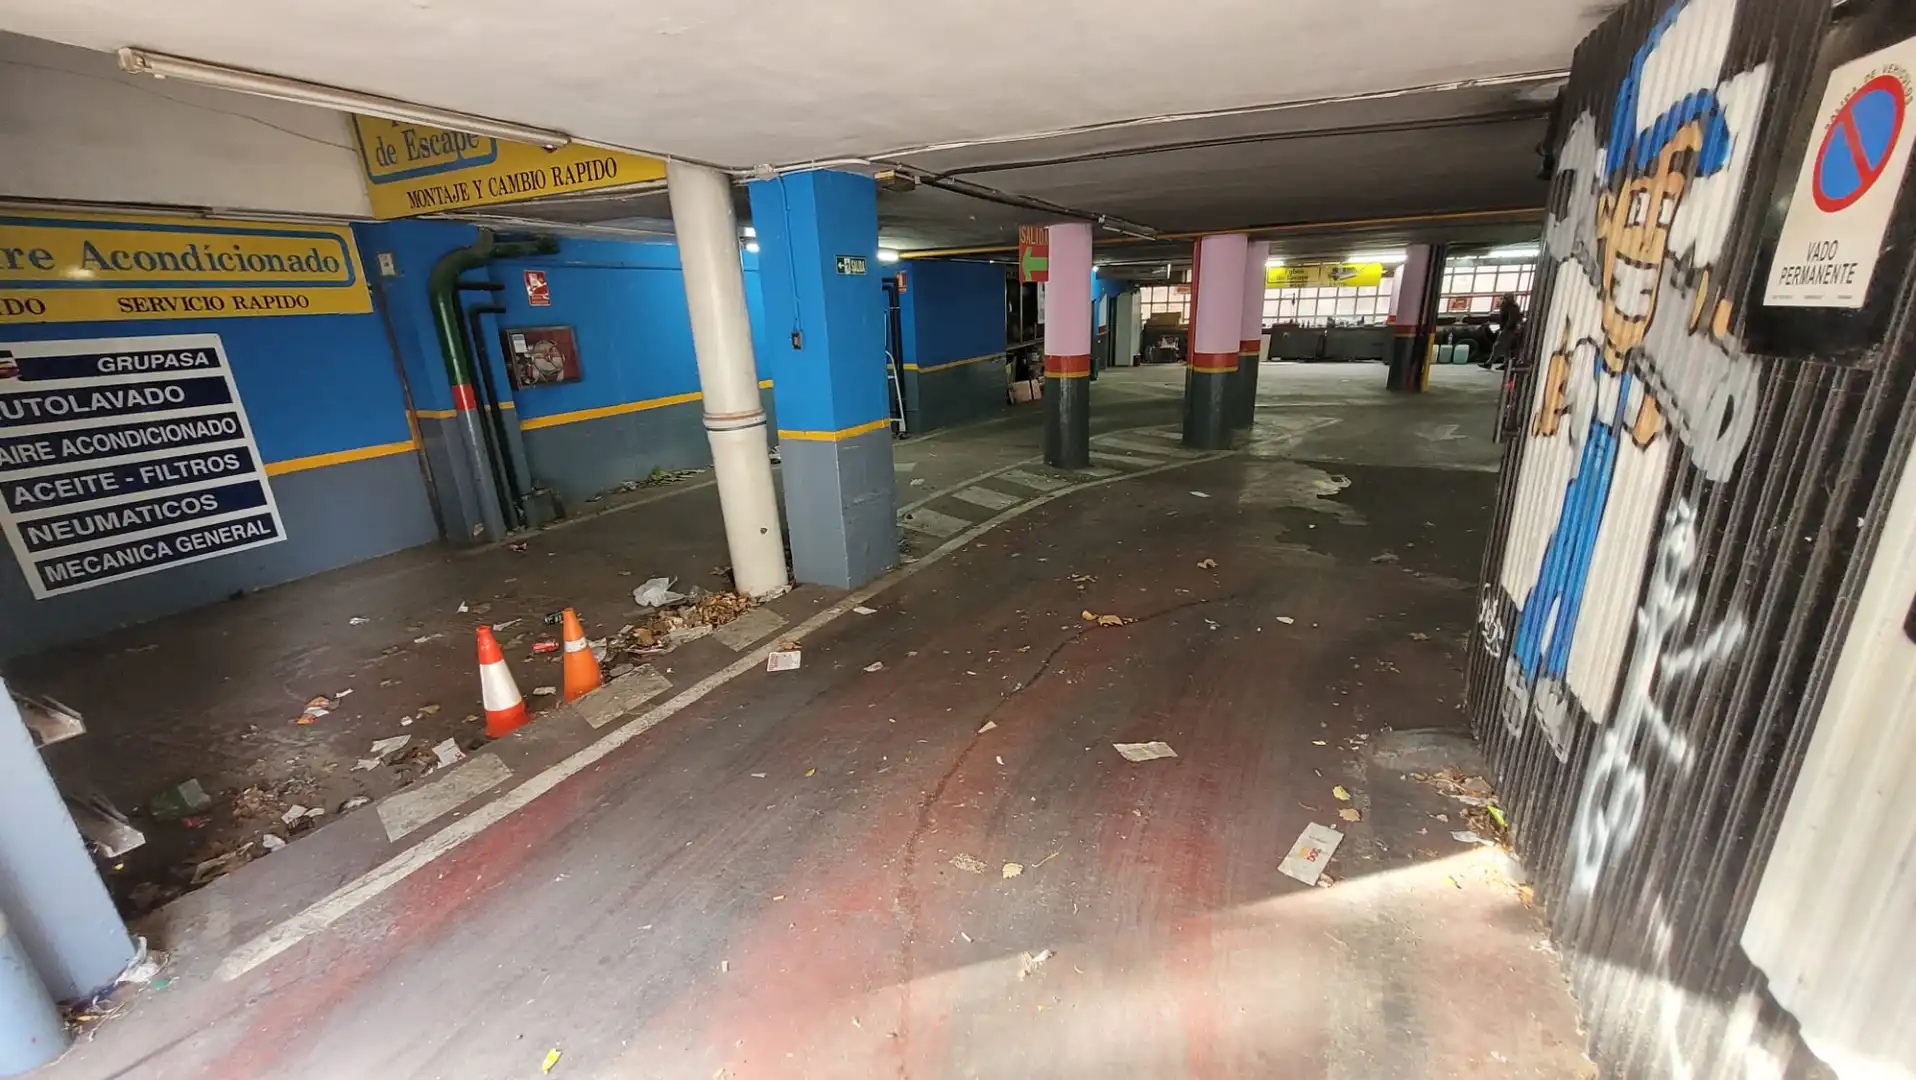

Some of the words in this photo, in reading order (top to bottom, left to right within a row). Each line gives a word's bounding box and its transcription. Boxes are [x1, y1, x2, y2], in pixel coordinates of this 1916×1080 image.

[376, 136, 398, 167] de
[407, 182, 470, 209] MONTAJE
[472, 179, 483, 199] Y
[488, 169, 546, 197] CAMBIO
[551, 157, 617, 187] RAPIDO
[1807, 240, 1838, 261] VADO
[1779, 262, 1858, 285] PERMANENTE
[117, 295, 225, 313] SERVICIO
[231, 294, 310, 311] RAPIDO
[97, 352, 209, 372] GRUPASA
[0, 386, 185, 421] UTOLAVADO
[0, 441, 56, 467] AIRE
[62, 417, 237, 457] ACONDICIONADO
[15, 472, 119, 506] ACEITE
[139, 454, 240, 484] FILTROS
[27, 494, 218, 545] NEUMATICOS
[44, 541, 173, 583] MECANICA
[175, 519, 271, 553] GENERAL
